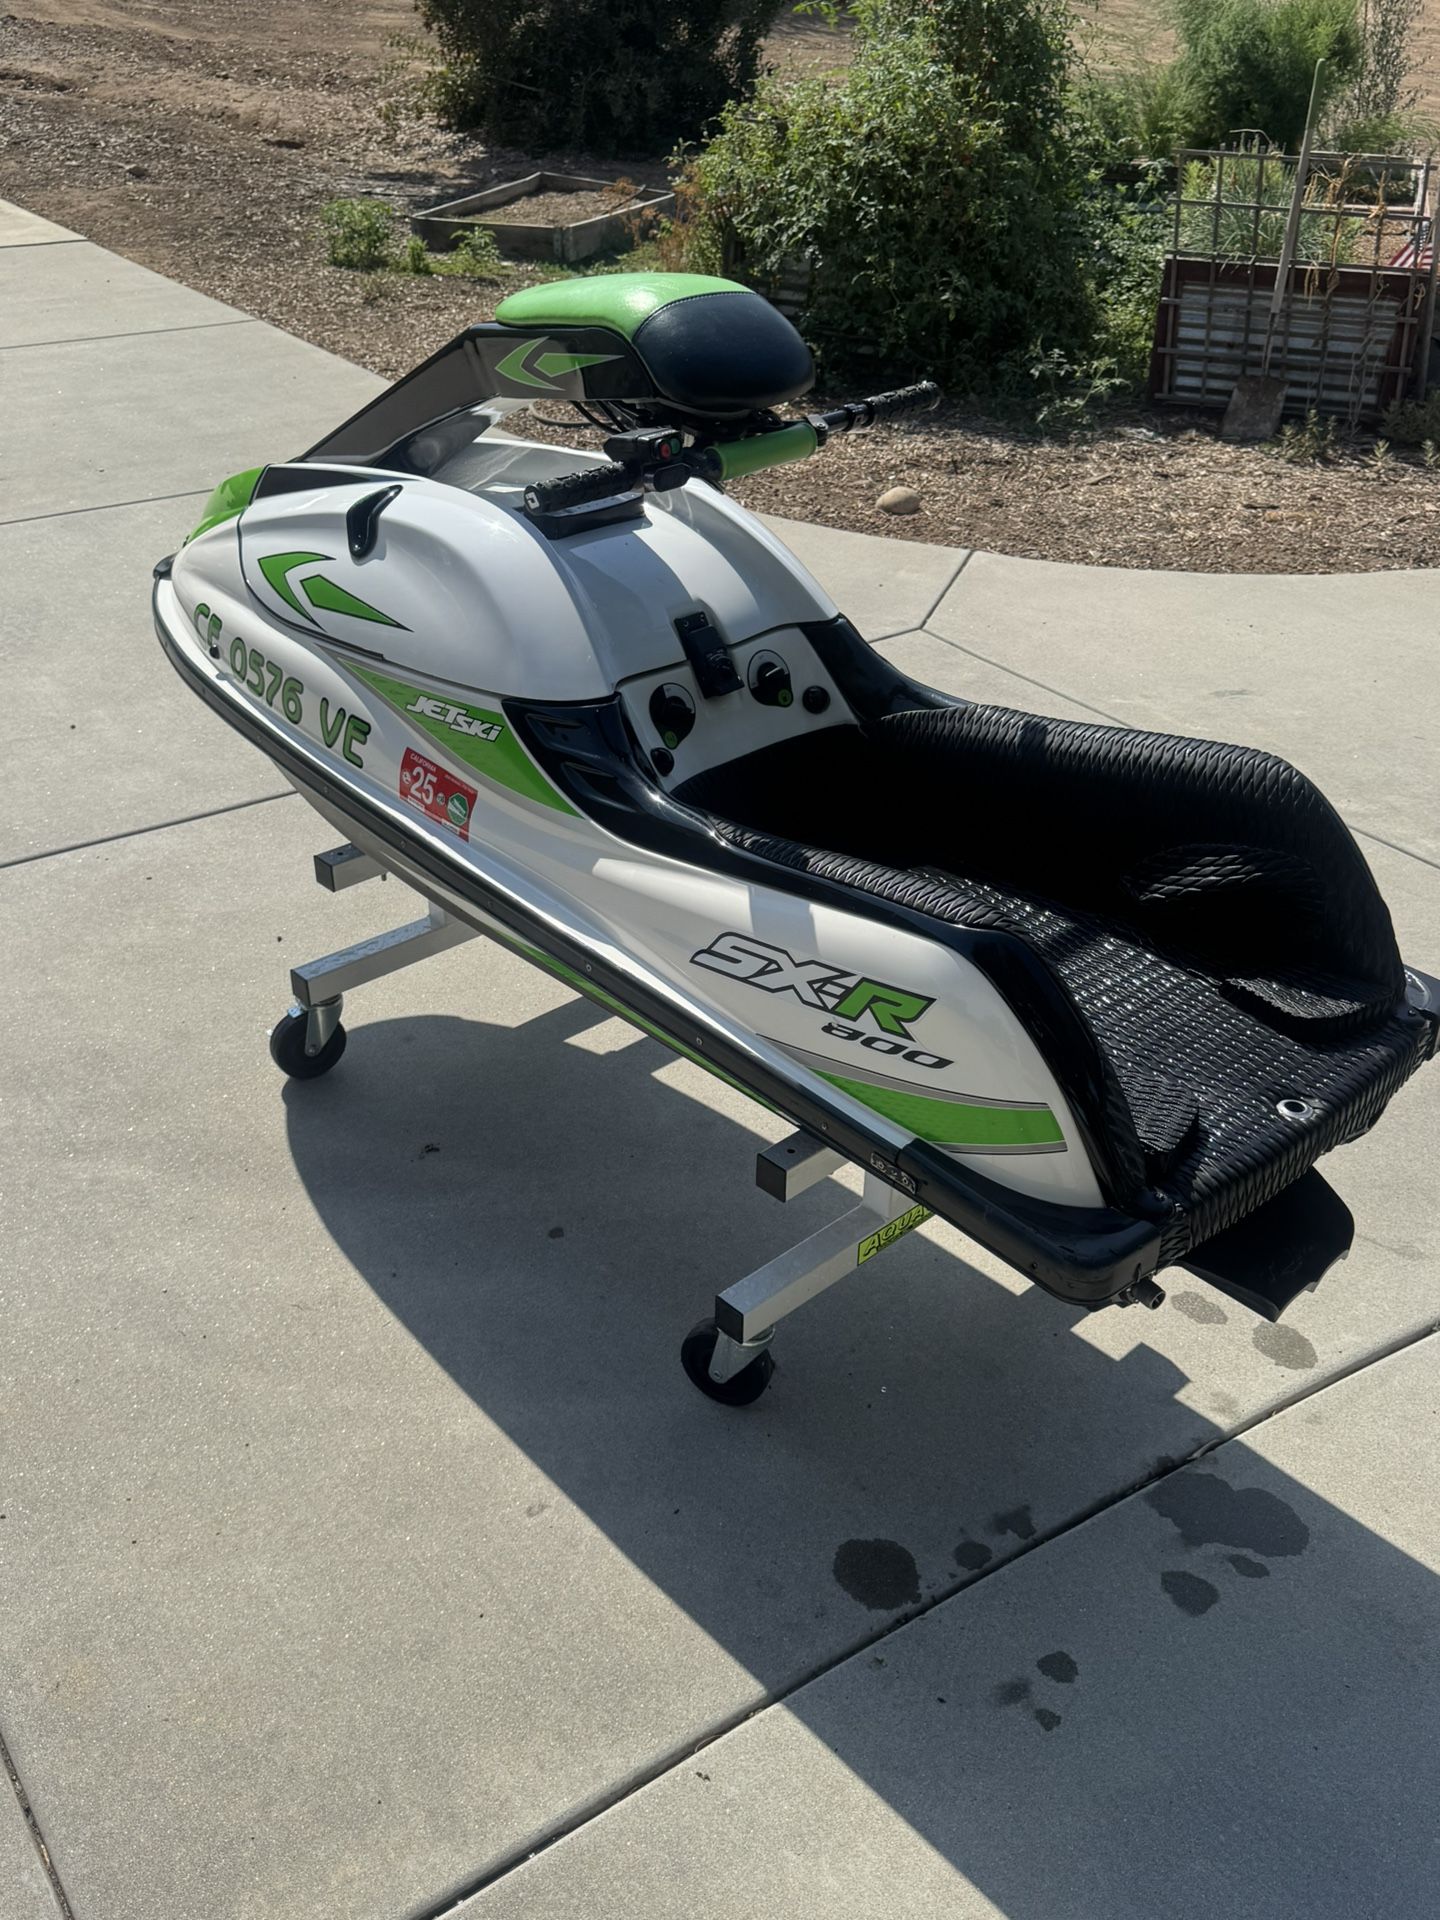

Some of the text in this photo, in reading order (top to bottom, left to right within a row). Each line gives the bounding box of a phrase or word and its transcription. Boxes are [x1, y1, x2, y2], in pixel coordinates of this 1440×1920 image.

[194, 603, 372, 769] CF 0576 VE
[409, 752, 438, 773] CALIFORNIA
[409, 766, 438, 806] 25
[821, 1022, 955, 1070] 800
